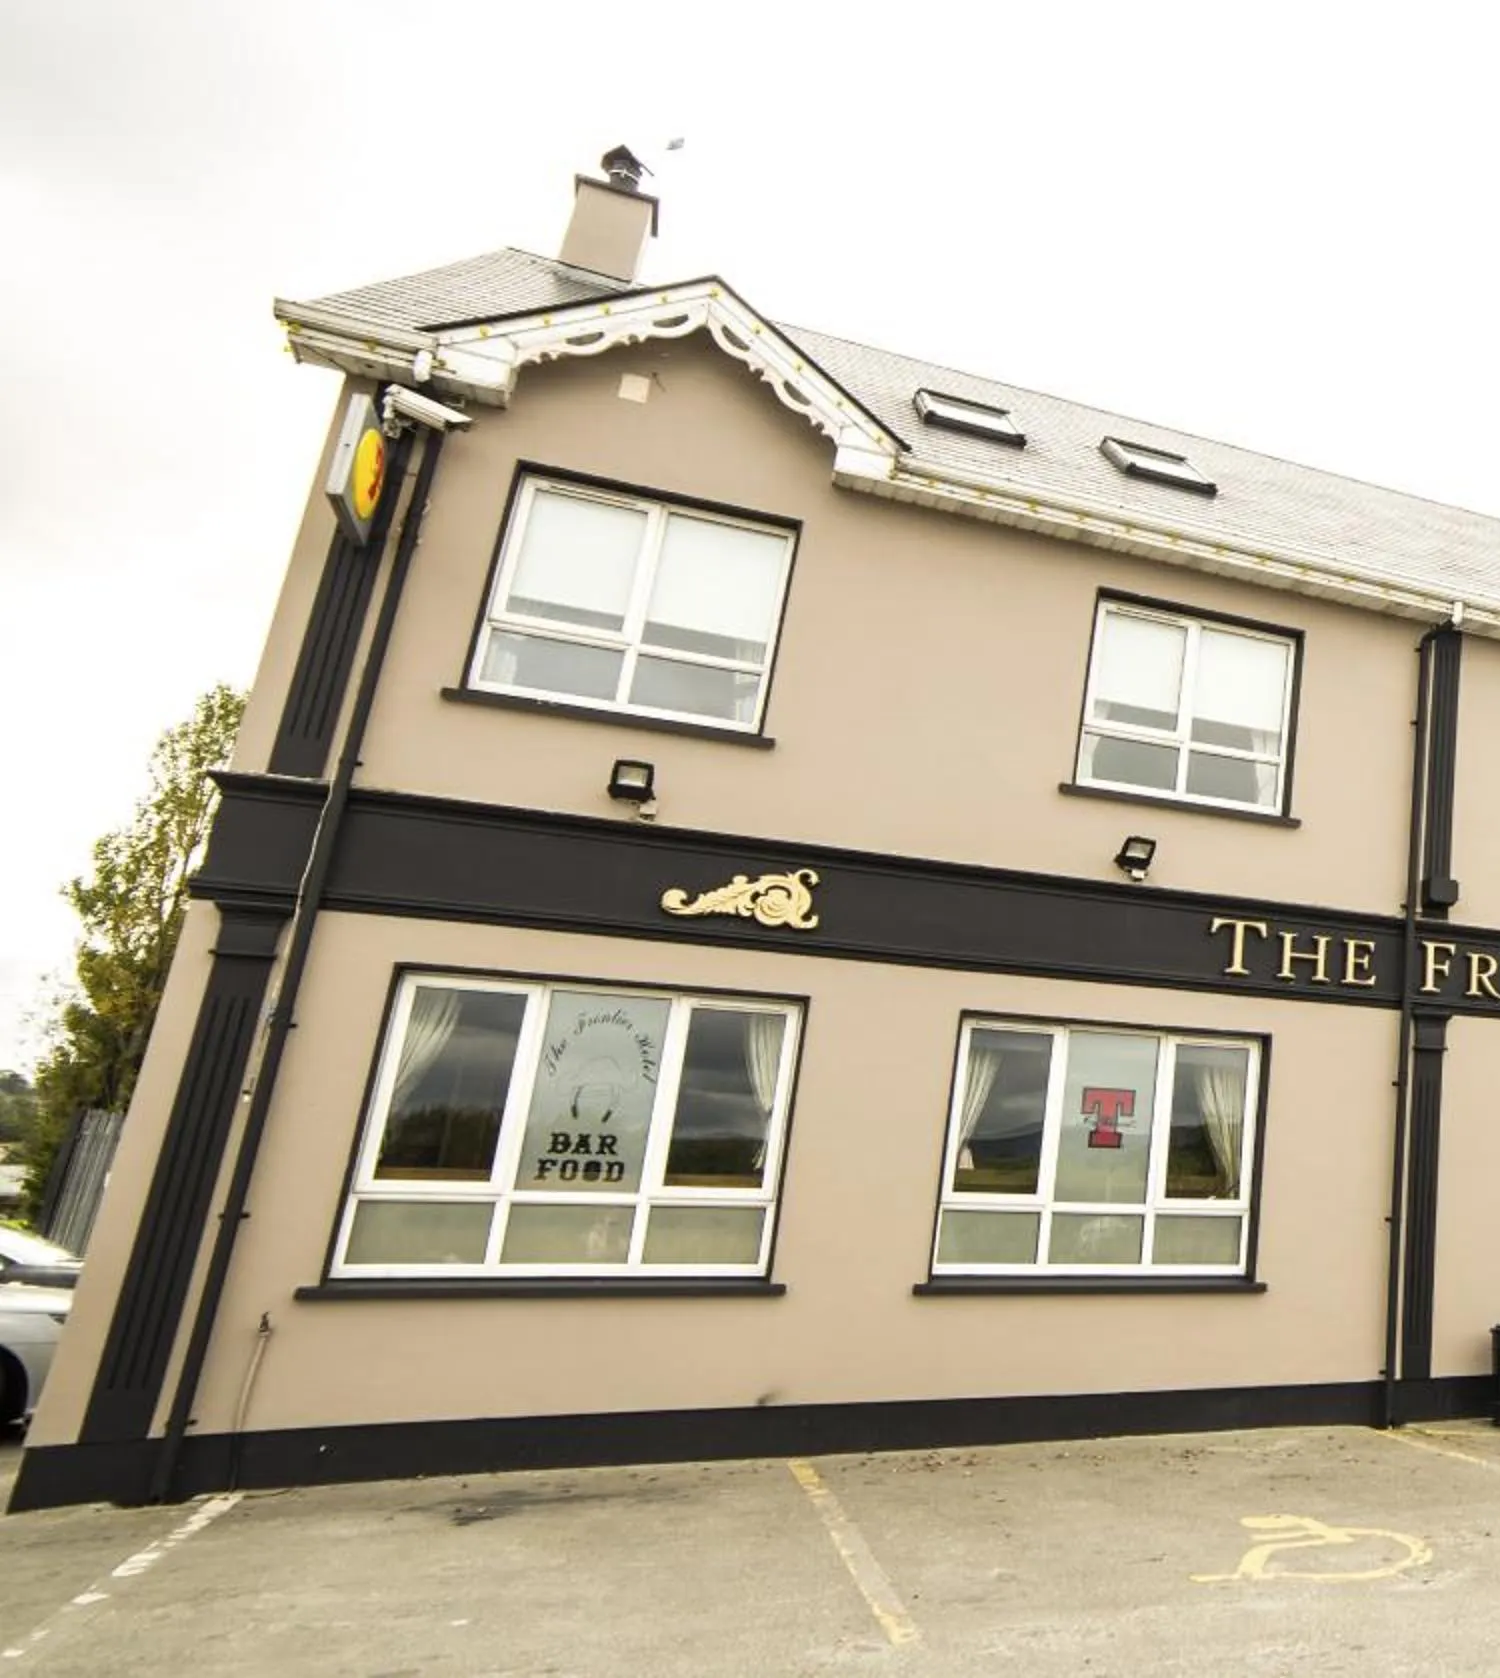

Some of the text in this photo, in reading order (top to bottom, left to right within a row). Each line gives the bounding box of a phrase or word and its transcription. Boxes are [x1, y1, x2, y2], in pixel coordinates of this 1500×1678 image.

[1209, 917, 1377, 986] THE
[547, 1131, 619, 1156] BAR
[533, 1158, 625, 1182] FOOD
